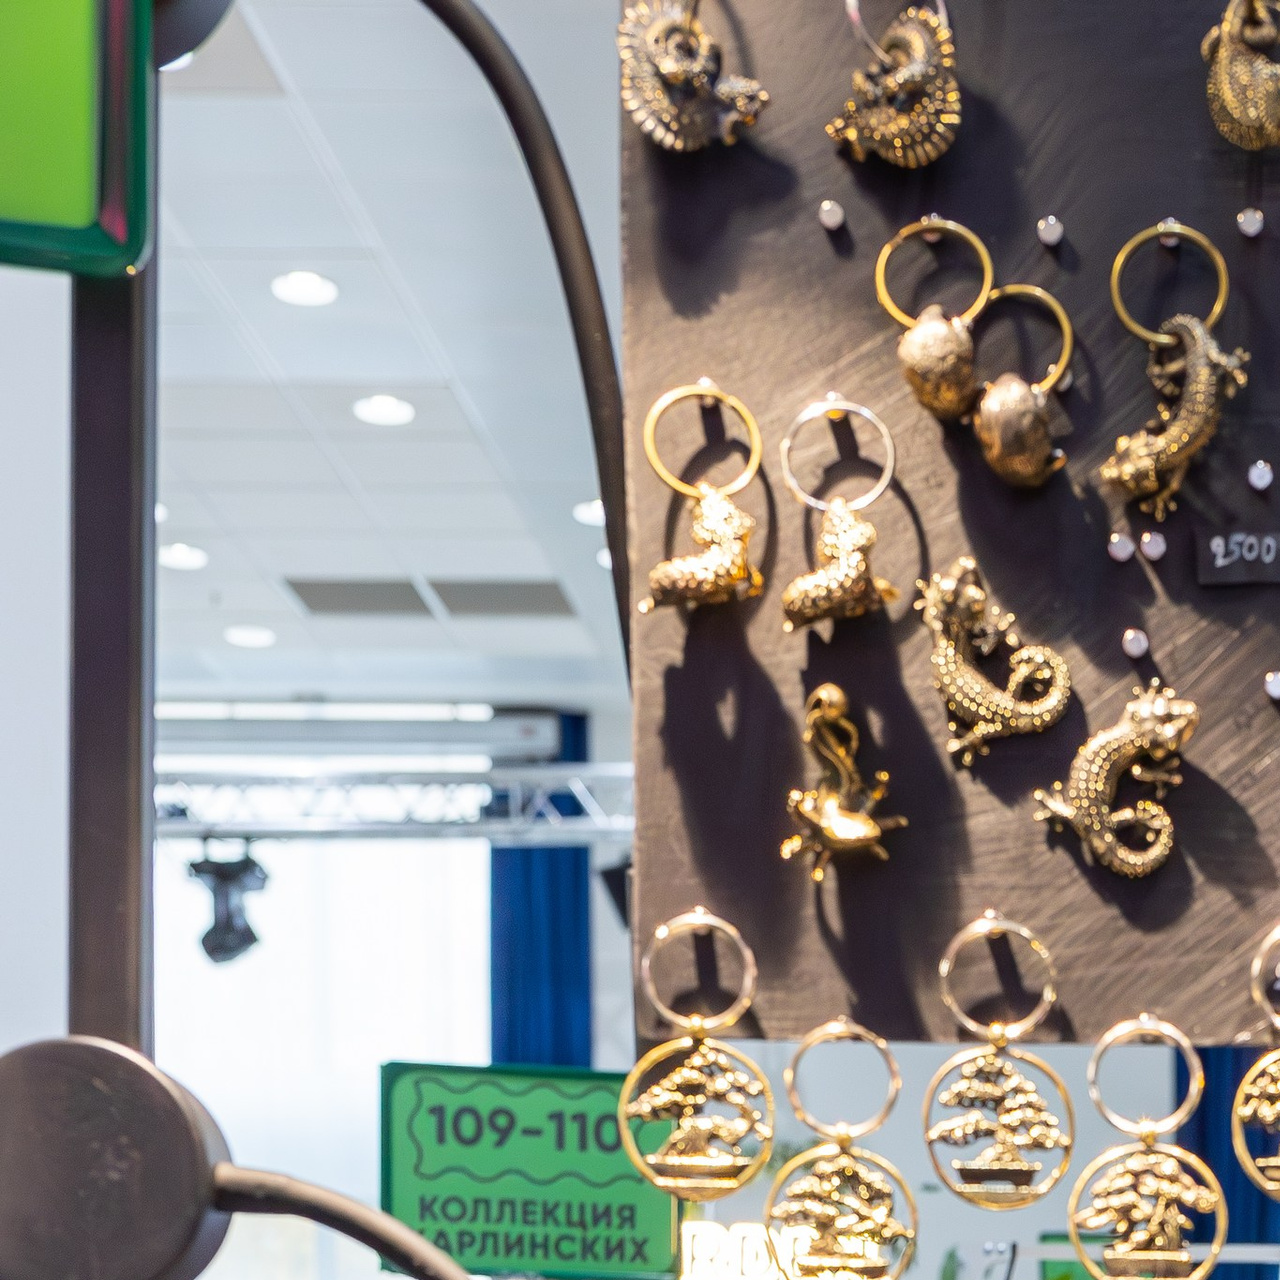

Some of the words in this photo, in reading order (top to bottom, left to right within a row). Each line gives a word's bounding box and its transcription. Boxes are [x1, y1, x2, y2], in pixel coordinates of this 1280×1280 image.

[1209, 532, 1277, 568] 2500
[427, 1104, 622, 1154] 109-110
[418, 1194, 637, 1231] КОЛЛЕКЦИЯ
[418, 1228, 650, 1264] АРЛИНСКИХ
